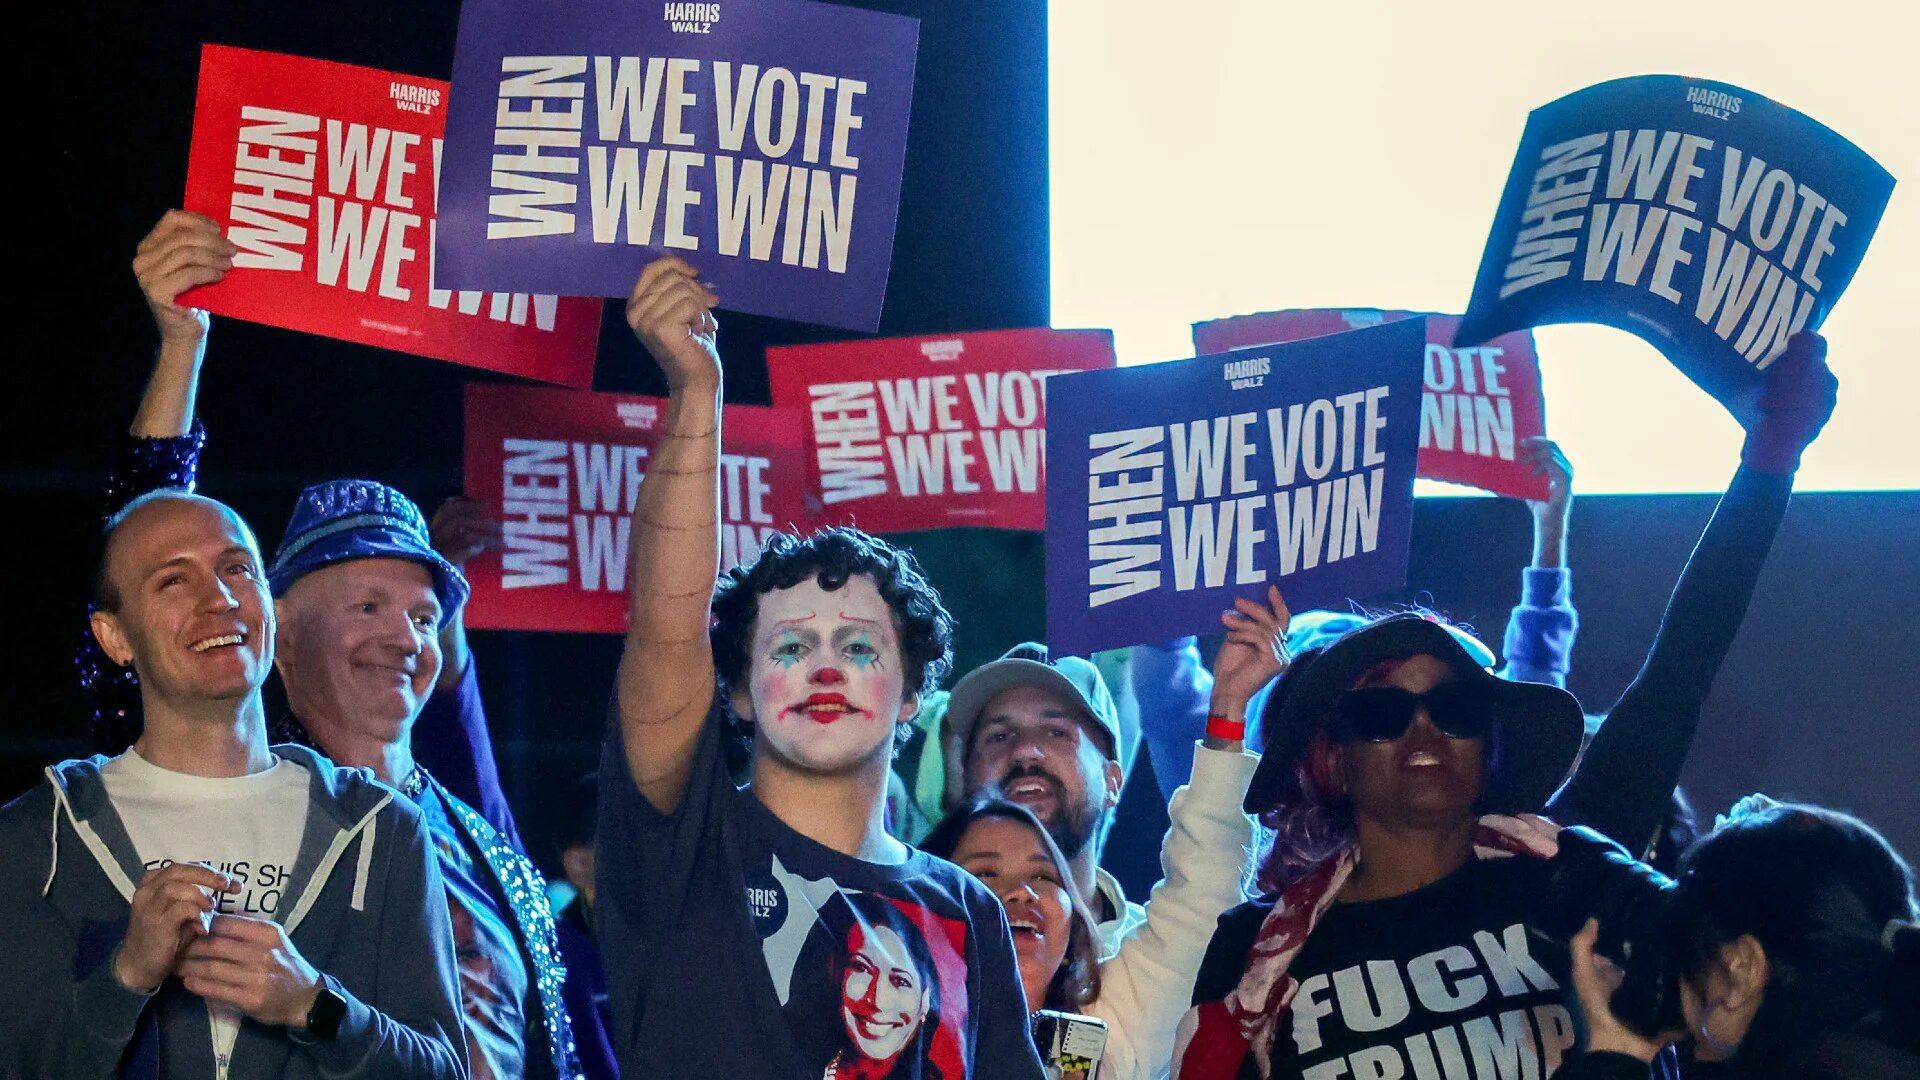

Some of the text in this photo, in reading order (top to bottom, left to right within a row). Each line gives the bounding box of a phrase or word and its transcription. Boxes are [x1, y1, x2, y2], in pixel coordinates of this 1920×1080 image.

[664, 2, 721, 22] HARRIS
[671, 21, 711, 33] WALZ
[390, 82, 441, 106] HARRIS
[396, 100, 431, 115] WALZ
[594, 56, 867, 169] WE VOTE
[1686, 86, 1742, 113] HARRIS
[1693, 103, 1731, 121] WALZ
[227, 105, 321, 271] WHEN
[326, 119, 420, 209] WE
[487, 56, 588, 239] WHEN
[317, 196, 420, 302] WE
[587, 146, 857, 273] WE WIN
[1499, 132, 1609, 299] WHEN
[1605, 129, 1848, 292] WE VOTE
[1583, 204, 1816, 371] WE WIN
[876, 376, 963, 433] WE
[1223, 357, 1271, 380] HARRIS
[1424, 343, 1511, 396] OTE
[720, 454, 773, 523] TE
[808, 381, 888, 505] WHEN
[886, 431, 980, 497] WE
[1169, 385, 1390, 501] WE VOTE
[502, 439, 570, 589] WHEN
[1089, 426, 1164, 608] WHEN
[1168, 468, 1384, 592] WE WIN
[748, 888, 778, 907] RRIS
[1291, 923, 1560, 1055] FUCK
